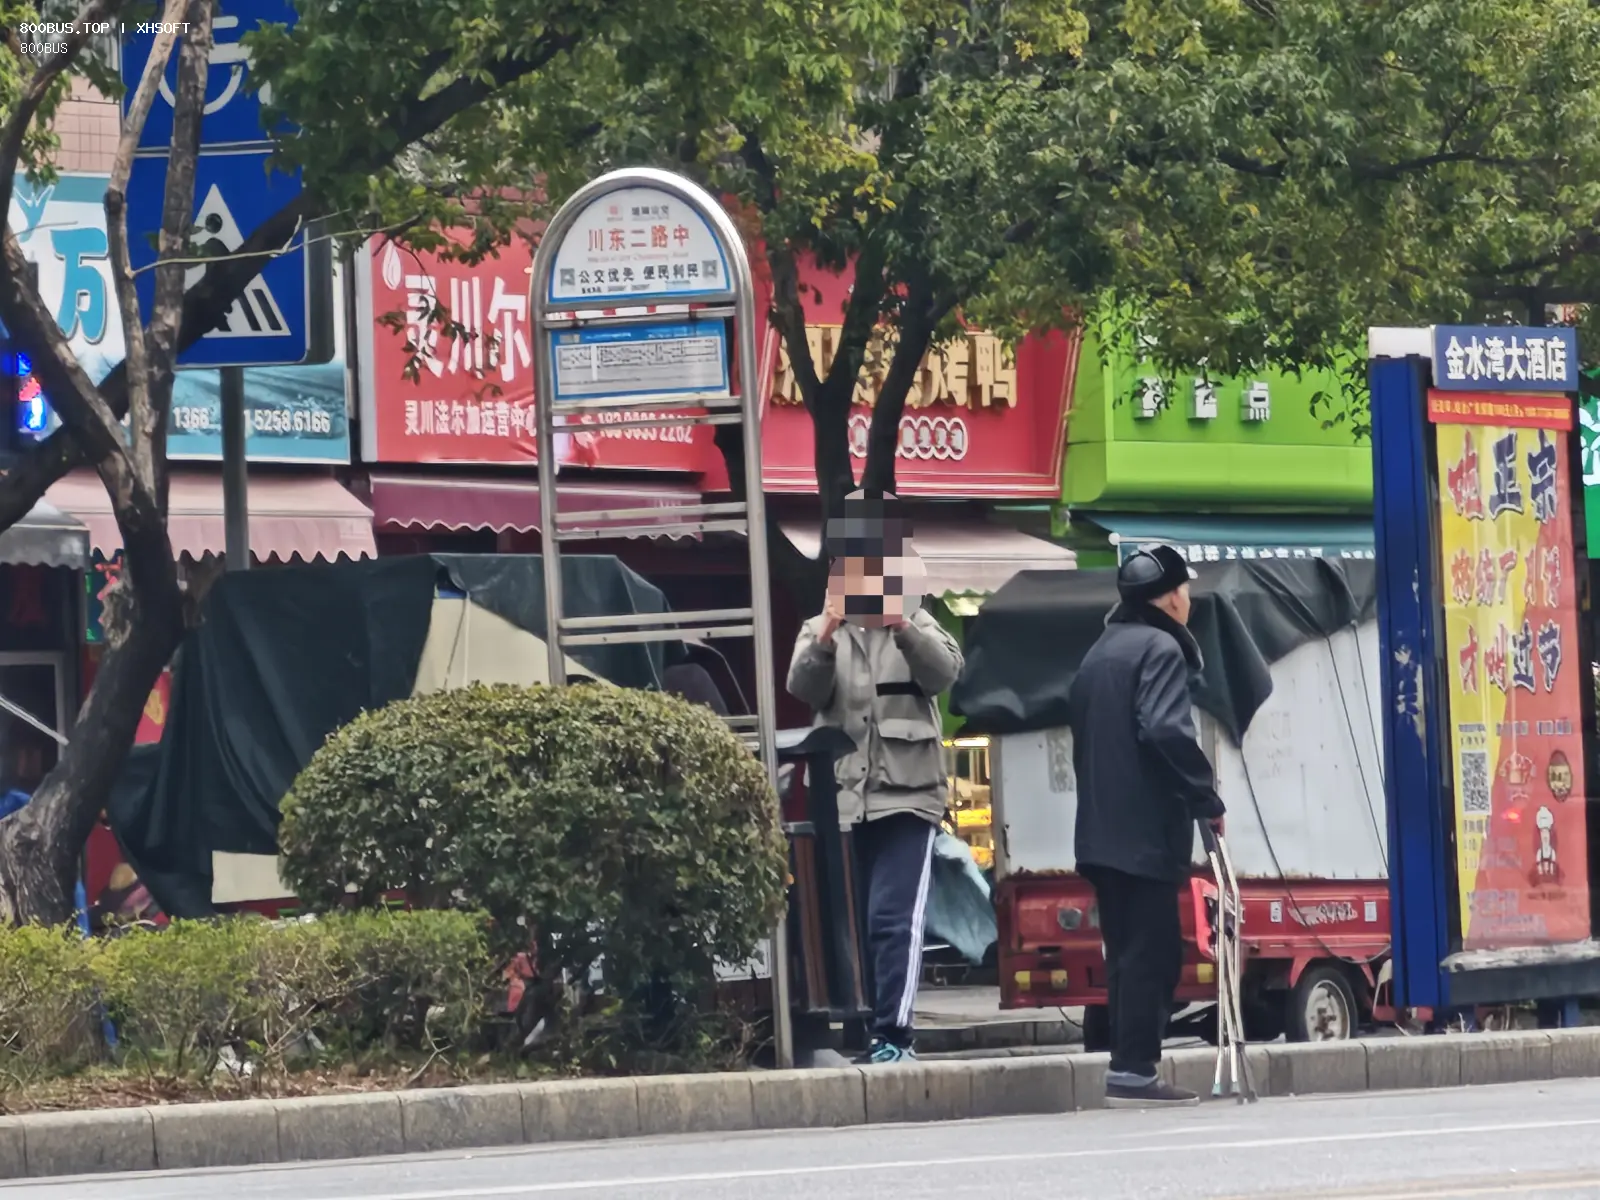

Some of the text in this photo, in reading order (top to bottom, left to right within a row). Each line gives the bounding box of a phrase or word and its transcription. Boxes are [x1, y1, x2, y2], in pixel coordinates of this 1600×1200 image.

[588, 224, 690, 251] 川东二路中
[578, 262, 700, 284] 公交优先 便民利民
[1444, 335, 1567, 381] 金水湾大酒店
